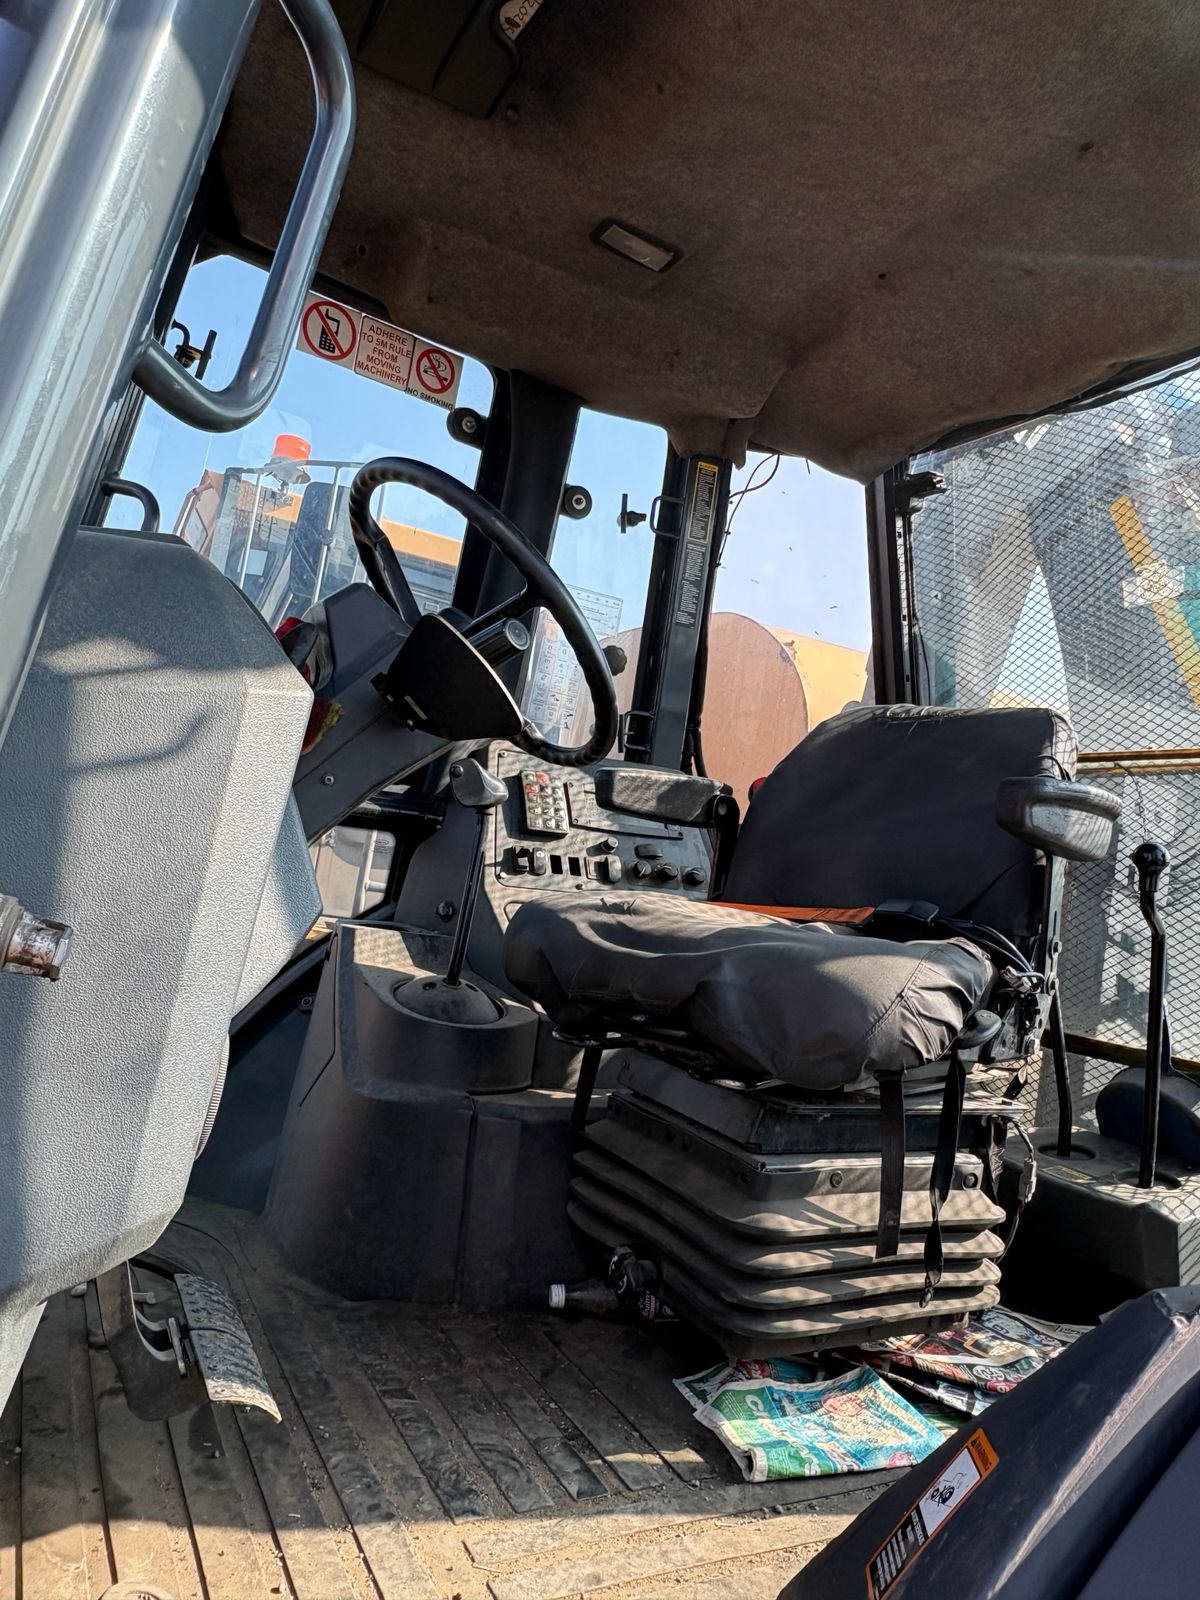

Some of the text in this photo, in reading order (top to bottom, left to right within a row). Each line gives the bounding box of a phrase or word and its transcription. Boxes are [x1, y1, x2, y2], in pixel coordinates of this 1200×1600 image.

[362, 332, 413, 359] TO 5M RULE
[369, 324, 408, 347] ADHERE
[366, 354, 402, 374] MOVING
[372, 347, 398, 364] FROM
[356, 361, 408, 386] MACHINERY
[406, 387, 454, 411] NO SMOKING
